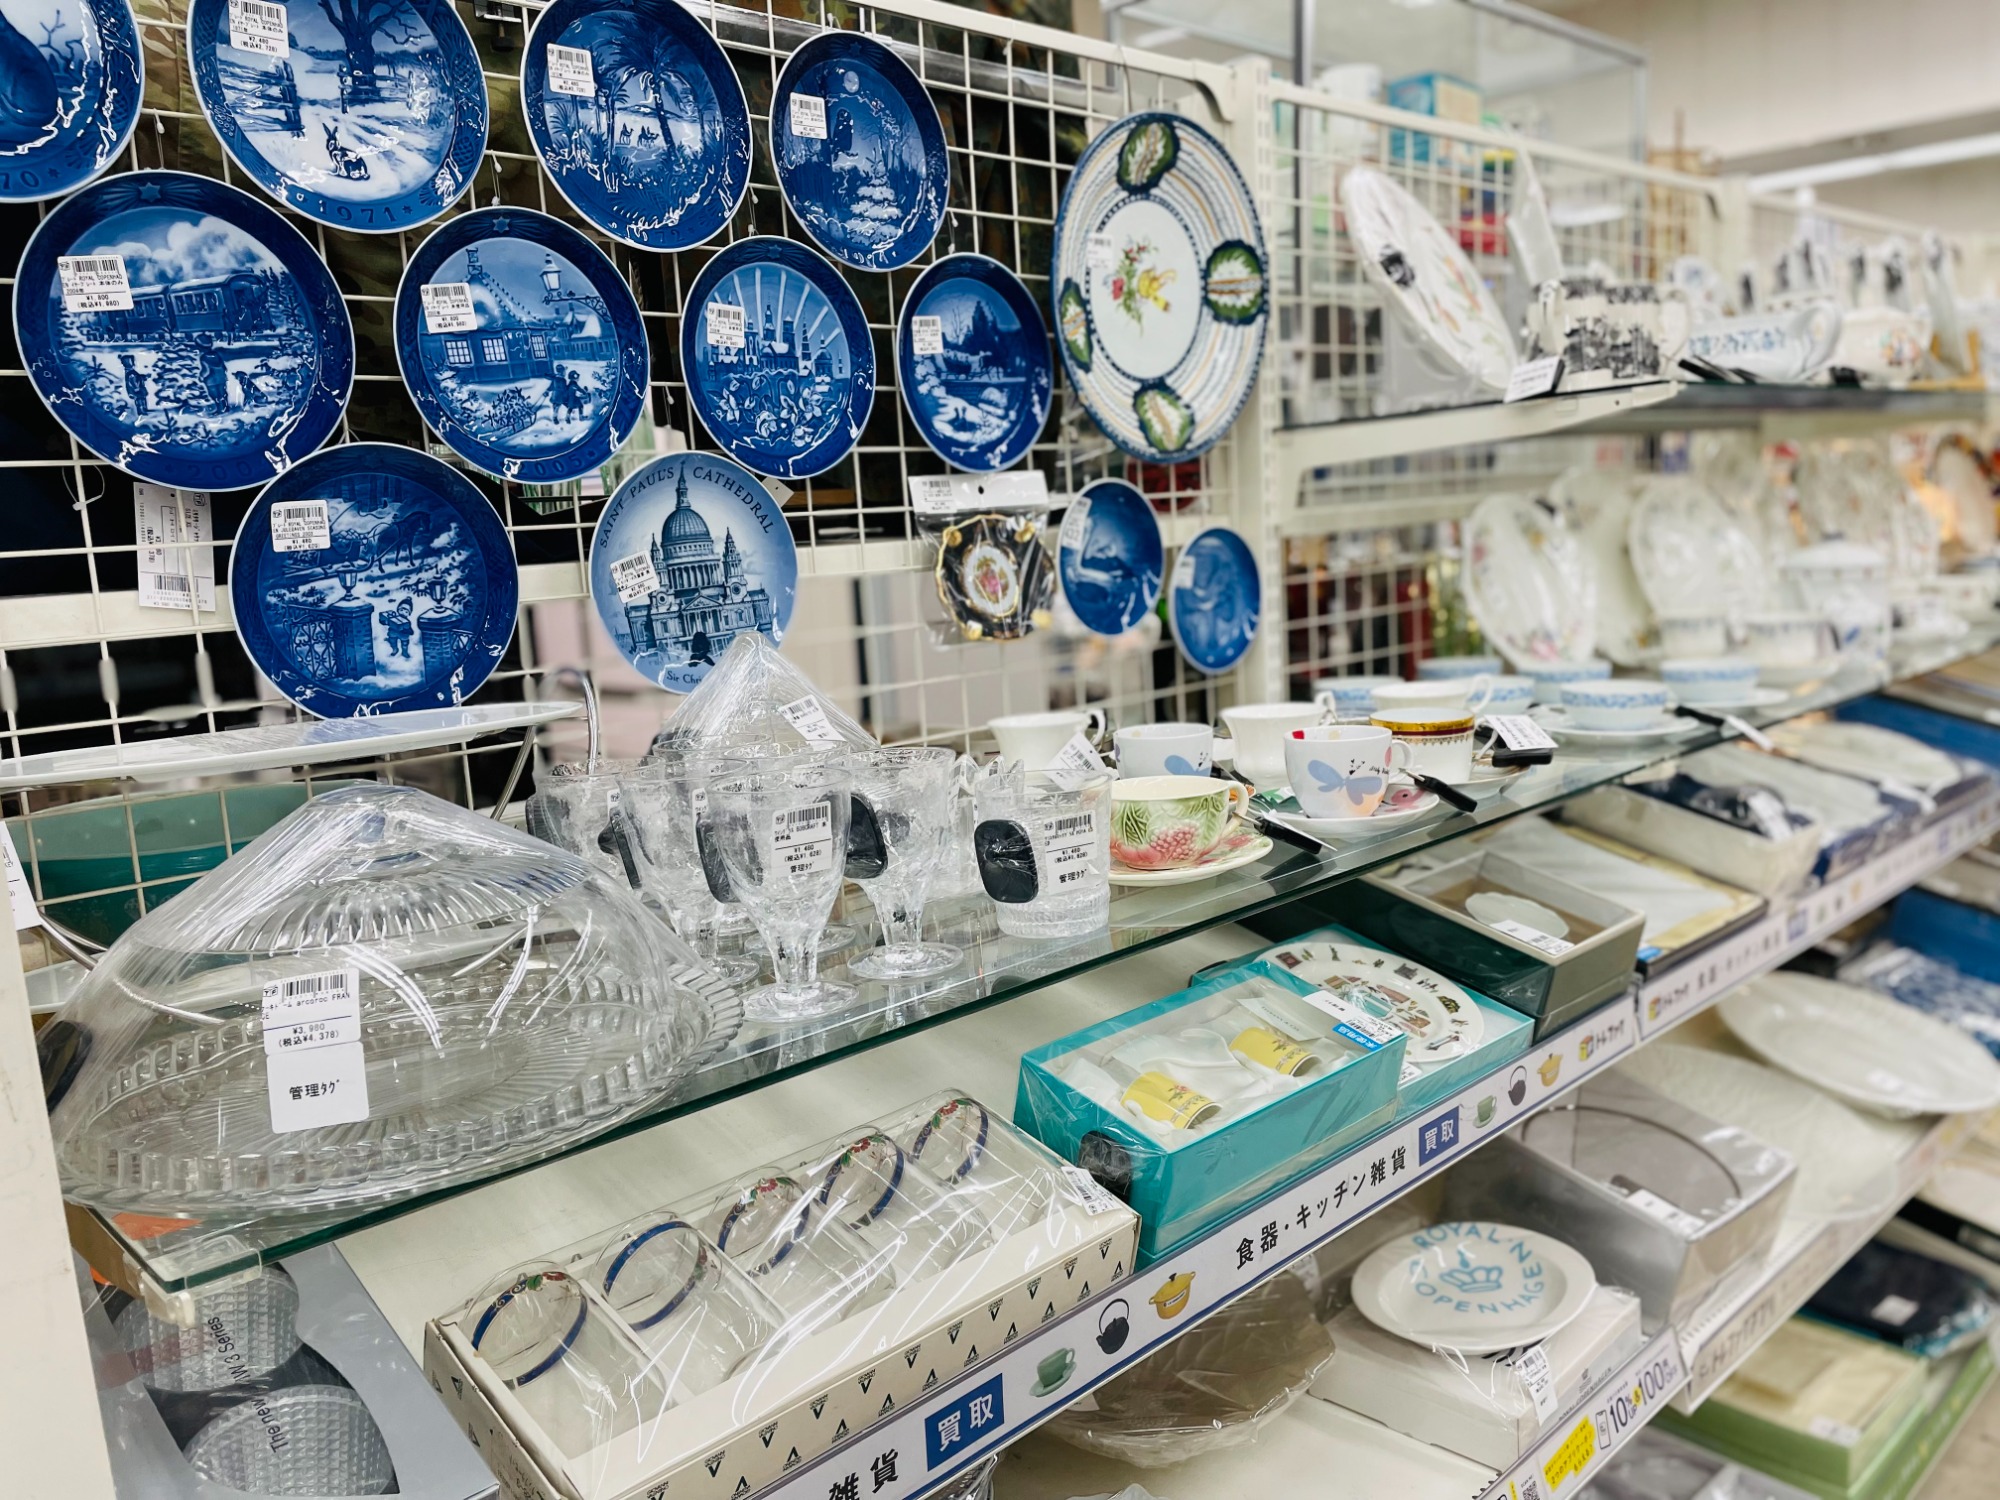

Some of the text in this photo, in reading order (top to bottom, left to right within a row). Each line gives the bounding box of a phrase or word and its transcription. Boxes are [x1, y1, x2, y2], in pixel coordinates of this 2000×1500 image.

[319, 199, 397, 223] 1971
[600, 466, 774, 549] SAINT PAUL'S CATHEDRAL
[666, 670, 679, 682] Sir
[297, 997, 328, 1007] arcoroc
[331, 992, 350, 1001] FRAN
[278, 1029, 340, 1048] (税込¥4,378)
[293, 1022, 325, 1035] ¥3,980
[1424, 1119, 1454, 1155] 買取
[1236, 1146, 1407, 1271] 食器・キッチン雑貨
[1412, 1222, 1501, 1250] ROYAL
[208, 1316, 235, 1354] Series
[224, 1353, 240, 1364] 3
[251, 1398, 289, 1454] The new
[937, 1393, 994, 1452] 買取
[829, 1449, 899, 1500] 雑貨
